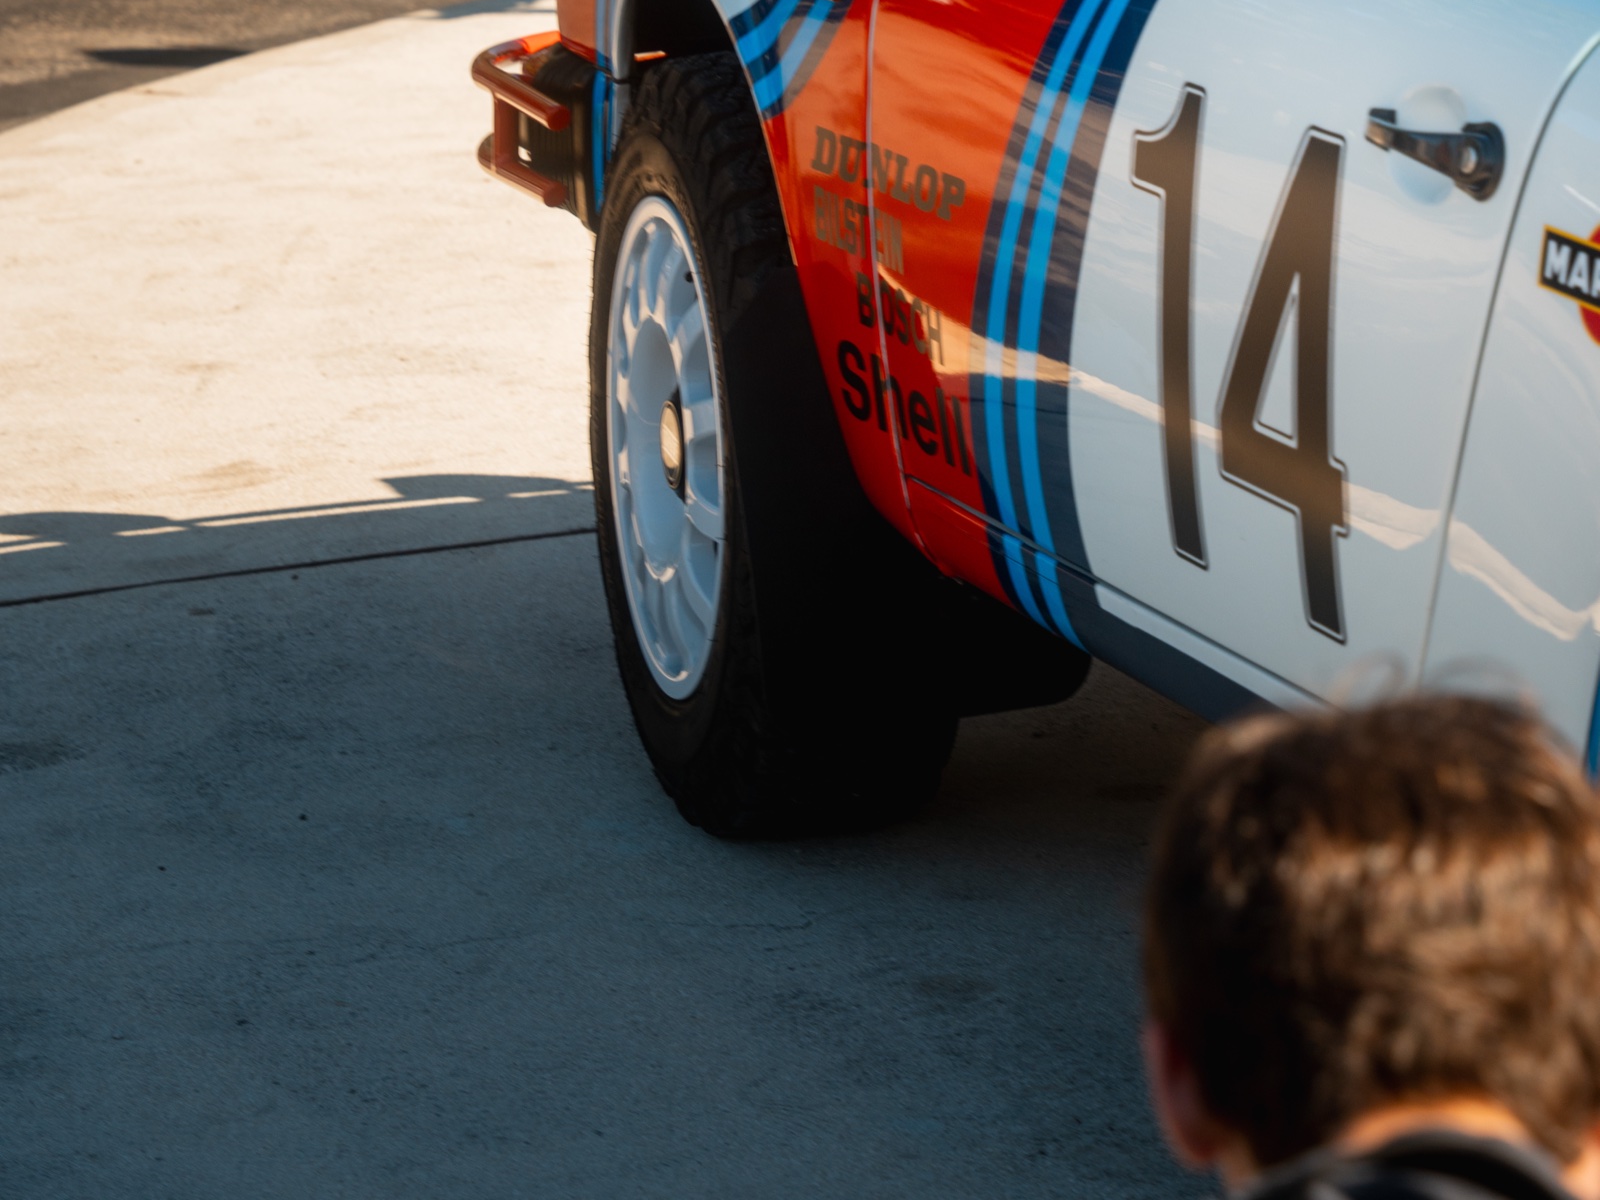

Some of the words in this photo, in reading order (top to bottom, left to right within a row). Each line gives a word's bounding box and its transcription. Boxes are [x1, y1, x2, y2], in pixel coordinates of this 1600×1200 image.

[811, 125, 966, 222] DUNLOP
[814, 185, 904, 276] BILSTEIN
[856, 270, 944, 367] BOSCH
[1131, 81, 1350, 645] 14
[837, 340, 972, 478] Shell
